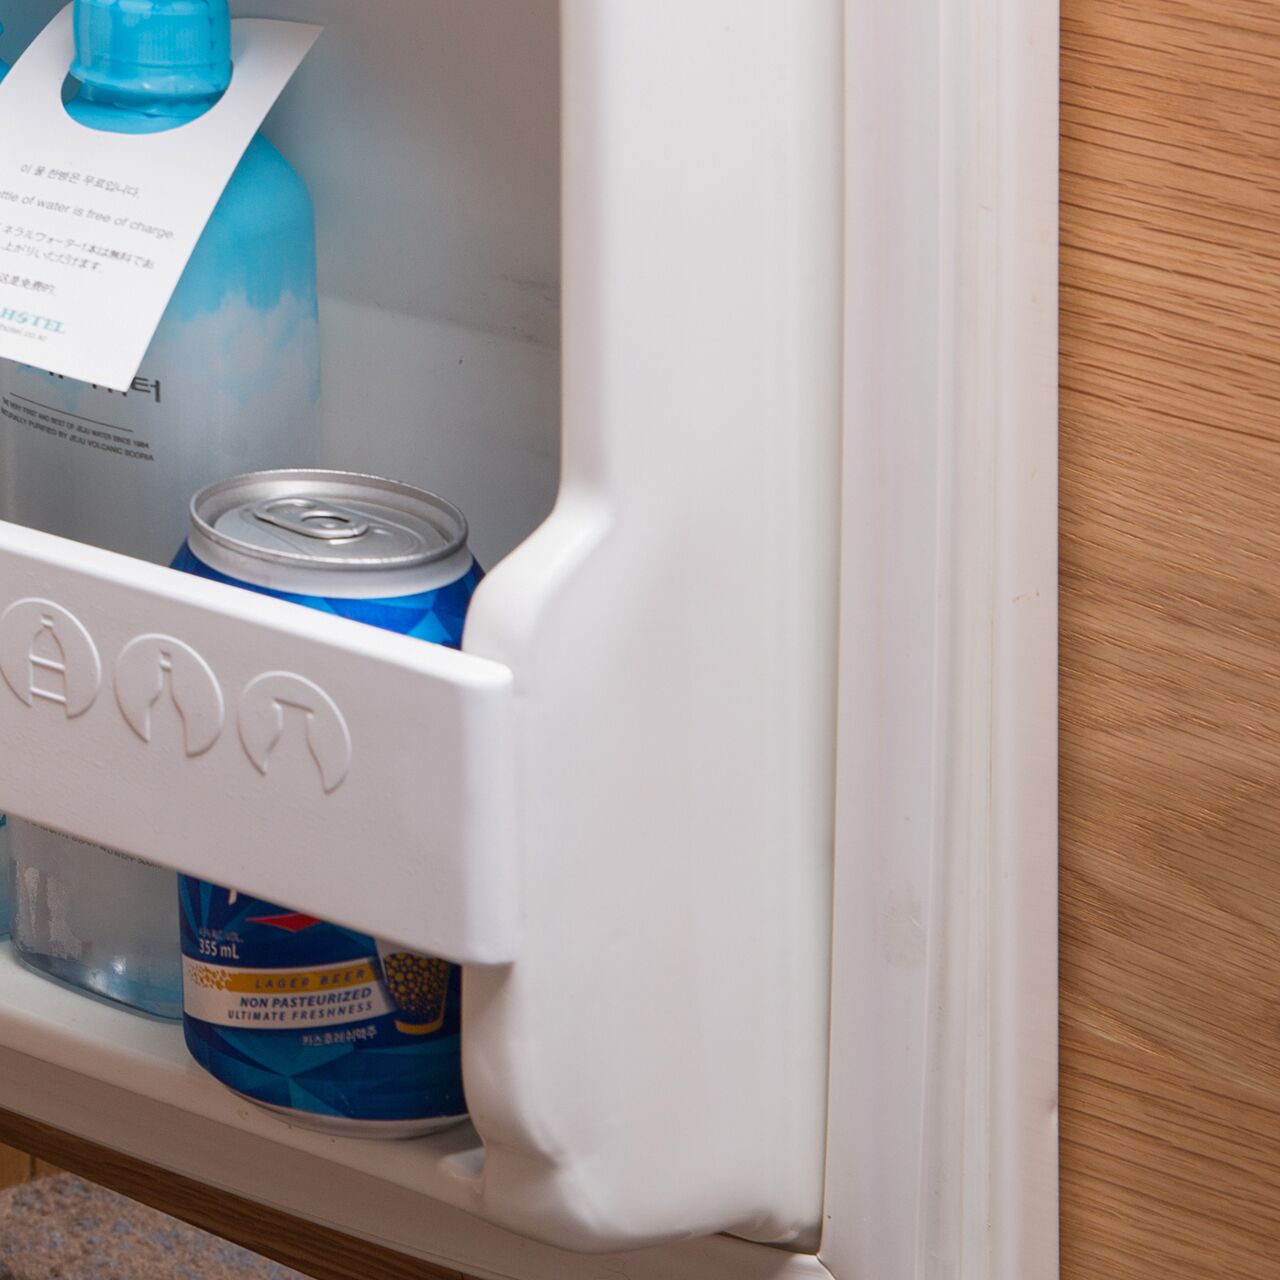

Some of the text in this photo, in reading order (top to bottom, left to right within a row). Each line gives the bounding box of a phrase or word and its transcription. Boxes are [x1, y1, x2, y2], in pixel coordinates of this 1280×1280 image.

[21, 164, 32, 174] 이
[22, 196, 34, 206] of
[37, 199, 70, 213] water
[74, 206, 83, 216] is
[87, 209, 111, 223] free
[113, 216, 128, 227] of
[129, 221, 175, 239] charge.
[199, 939, 239, 959] 355 mL
[256, 970, 366, 989] LAGER BEER
[240, 987, 372, 1008] NON PASTEURIZED
[228, 1002, 372, 1021] ULTIMATE FRESHNESS
